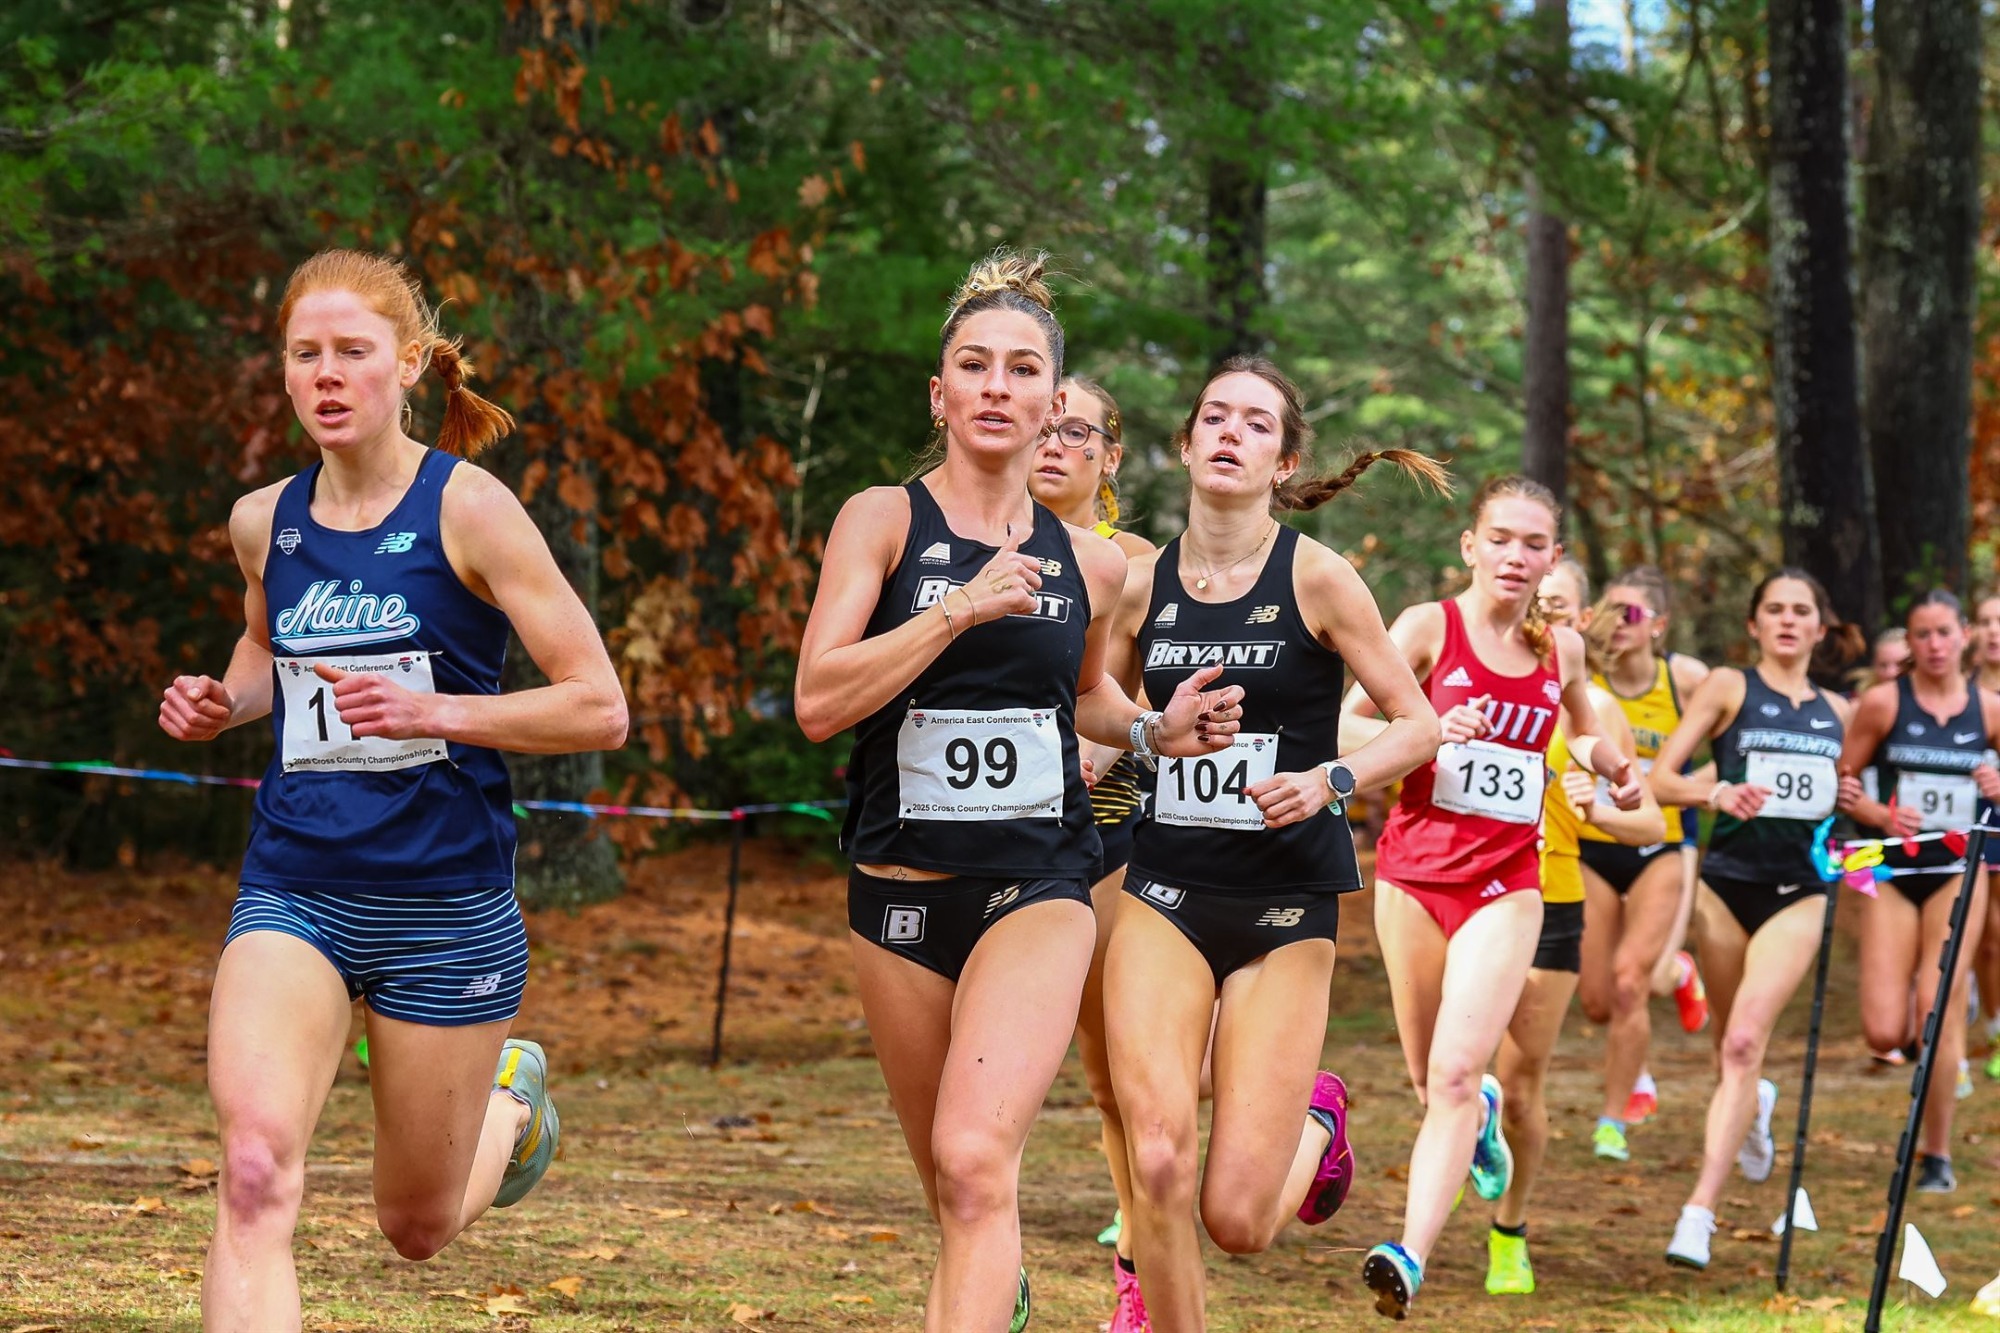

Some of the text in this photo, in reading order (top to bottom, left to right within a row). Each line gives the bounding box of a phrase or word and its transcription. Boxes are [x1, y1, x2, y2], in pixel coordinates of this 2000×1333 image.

[275, 579, 421, 640] Maine
[350, 663, 394, 672] Conference
[1147, 641, 1275, 668] BRYANT
[931, 716, 965, 724] America
[966, 716, 985, 724] East
[986, 716, 1031, 724] Conference
[336, 757, 366, 765] Country
[368, 748, 433, 764] Championships
[1739, 729, 1842, 758] BINGHAMTO
[945, 737, 1017, 789] 99
[1169, 757, 1248, 804] 104
[1458, 760, 1524, 801] 133
[1776, 772, 1812, 801] 98
[912, 802, 1051, 813] 2025 Cross Country Championships
[1923, 790, 1954, 815] 91
[1161, 812, 1173, 820] 2025
[1189, 815, 1212, 823] Country
[1213, 816, 1260, 826] Championships
